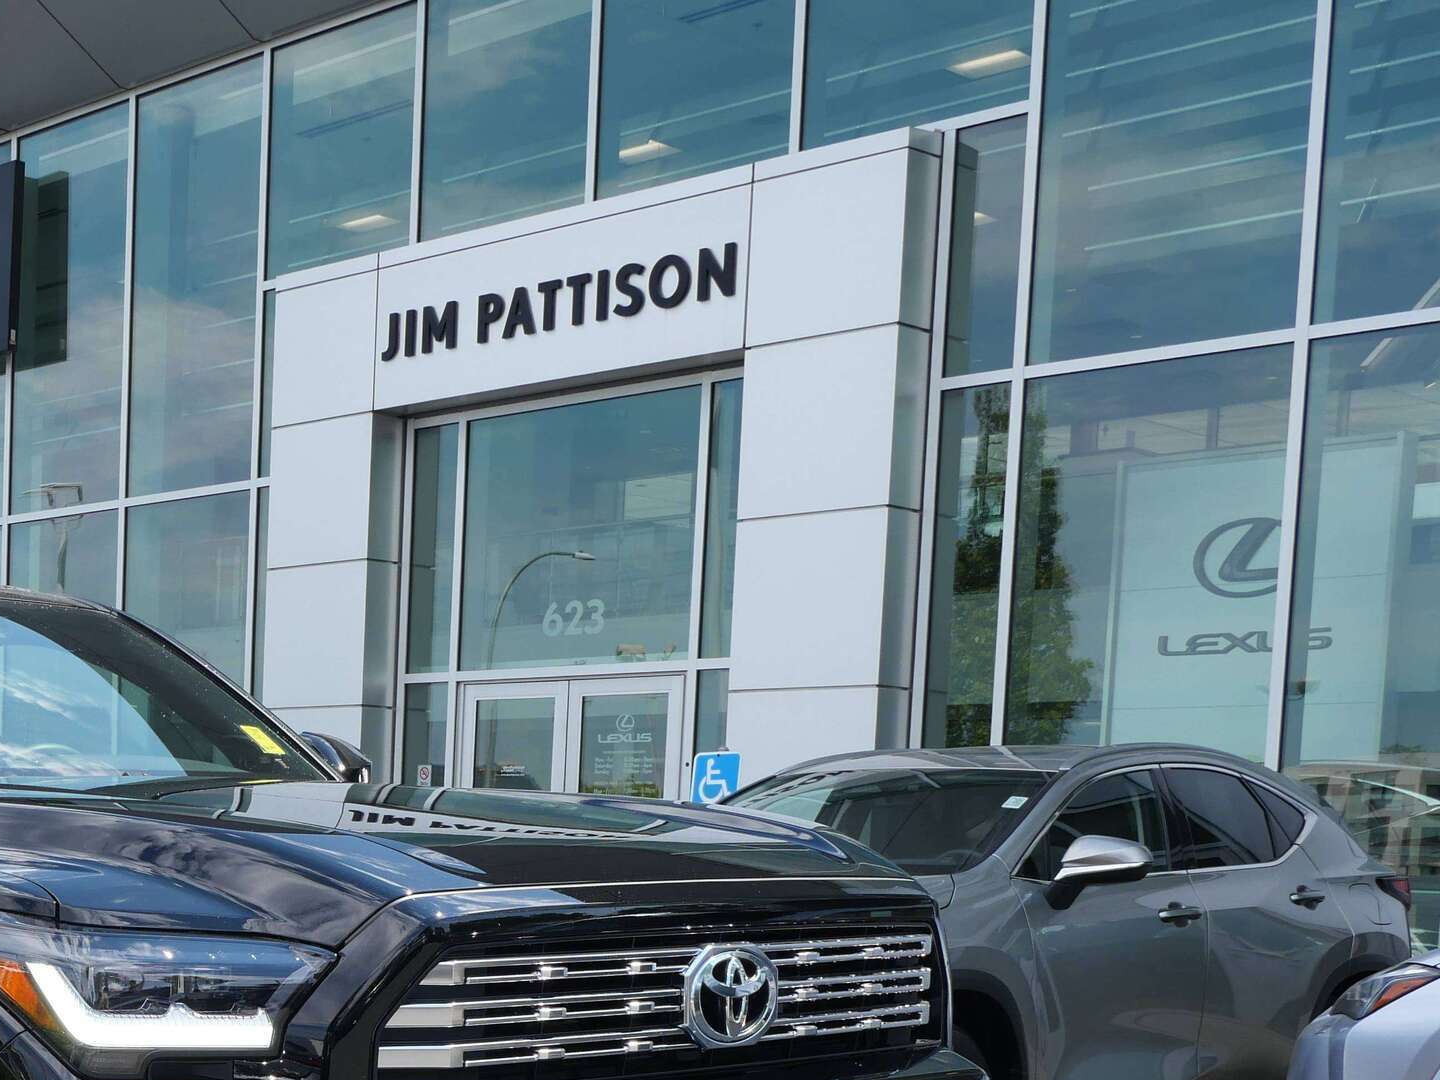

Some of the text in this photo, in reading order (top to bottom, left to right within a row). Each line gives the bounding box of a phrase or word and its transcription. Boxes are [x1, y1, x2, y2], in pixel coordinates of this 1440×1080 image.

[382, 242, 738, 361] JIM PATTISON
[542, 598, 604, 637] 623
[597, 733, 653, 743] LEXUS
